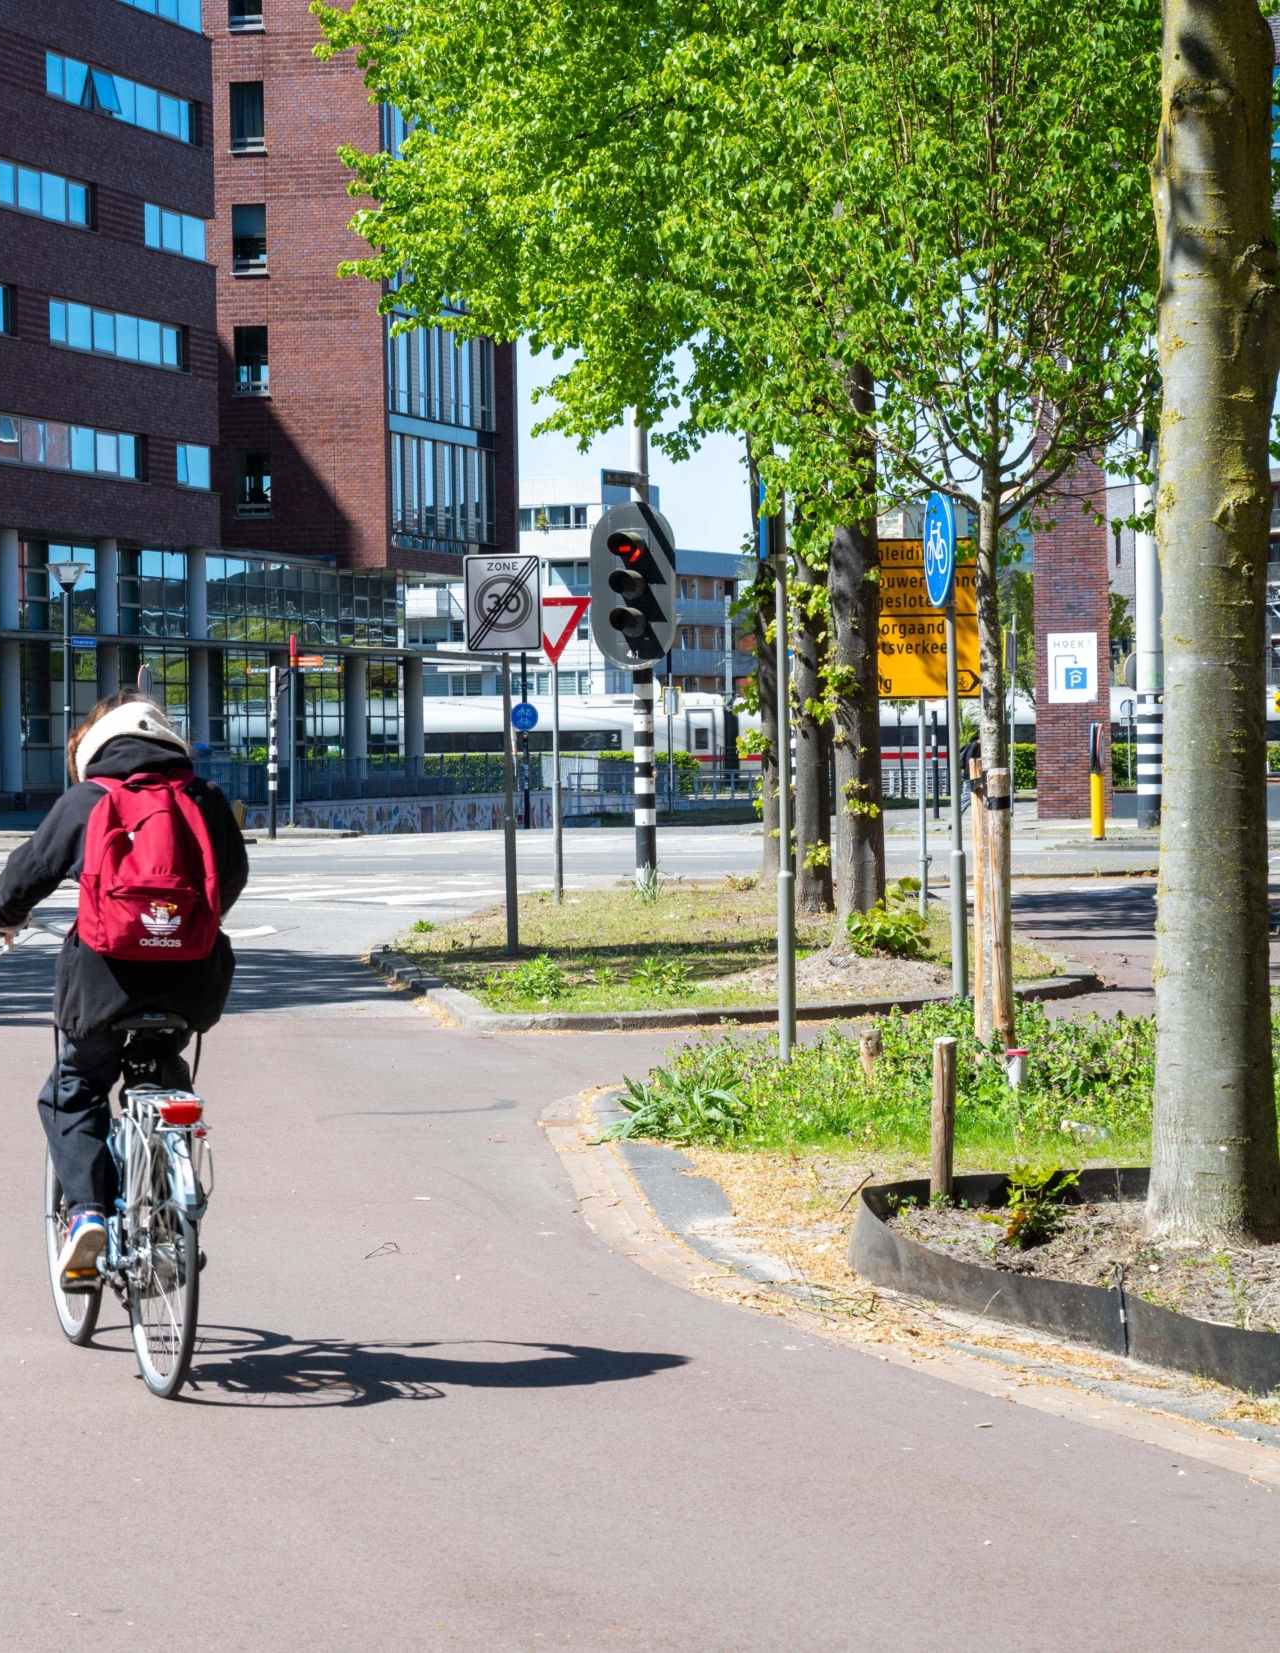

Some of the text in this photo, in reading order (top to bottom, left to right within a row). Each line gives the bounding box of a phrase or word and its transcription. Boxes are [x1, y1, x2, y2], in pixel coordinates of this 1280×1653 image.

[879, 545, 924, 561] leidi
[486, 561, 519, 571] ZONE
[486, 593, 521, 613] 30
[878, 639, 947, 655] tsverkee
[626, 649, 639, 659] 4.1
[610, 733, 619, 743] 2
[139, 936, 182, 948] adidas
